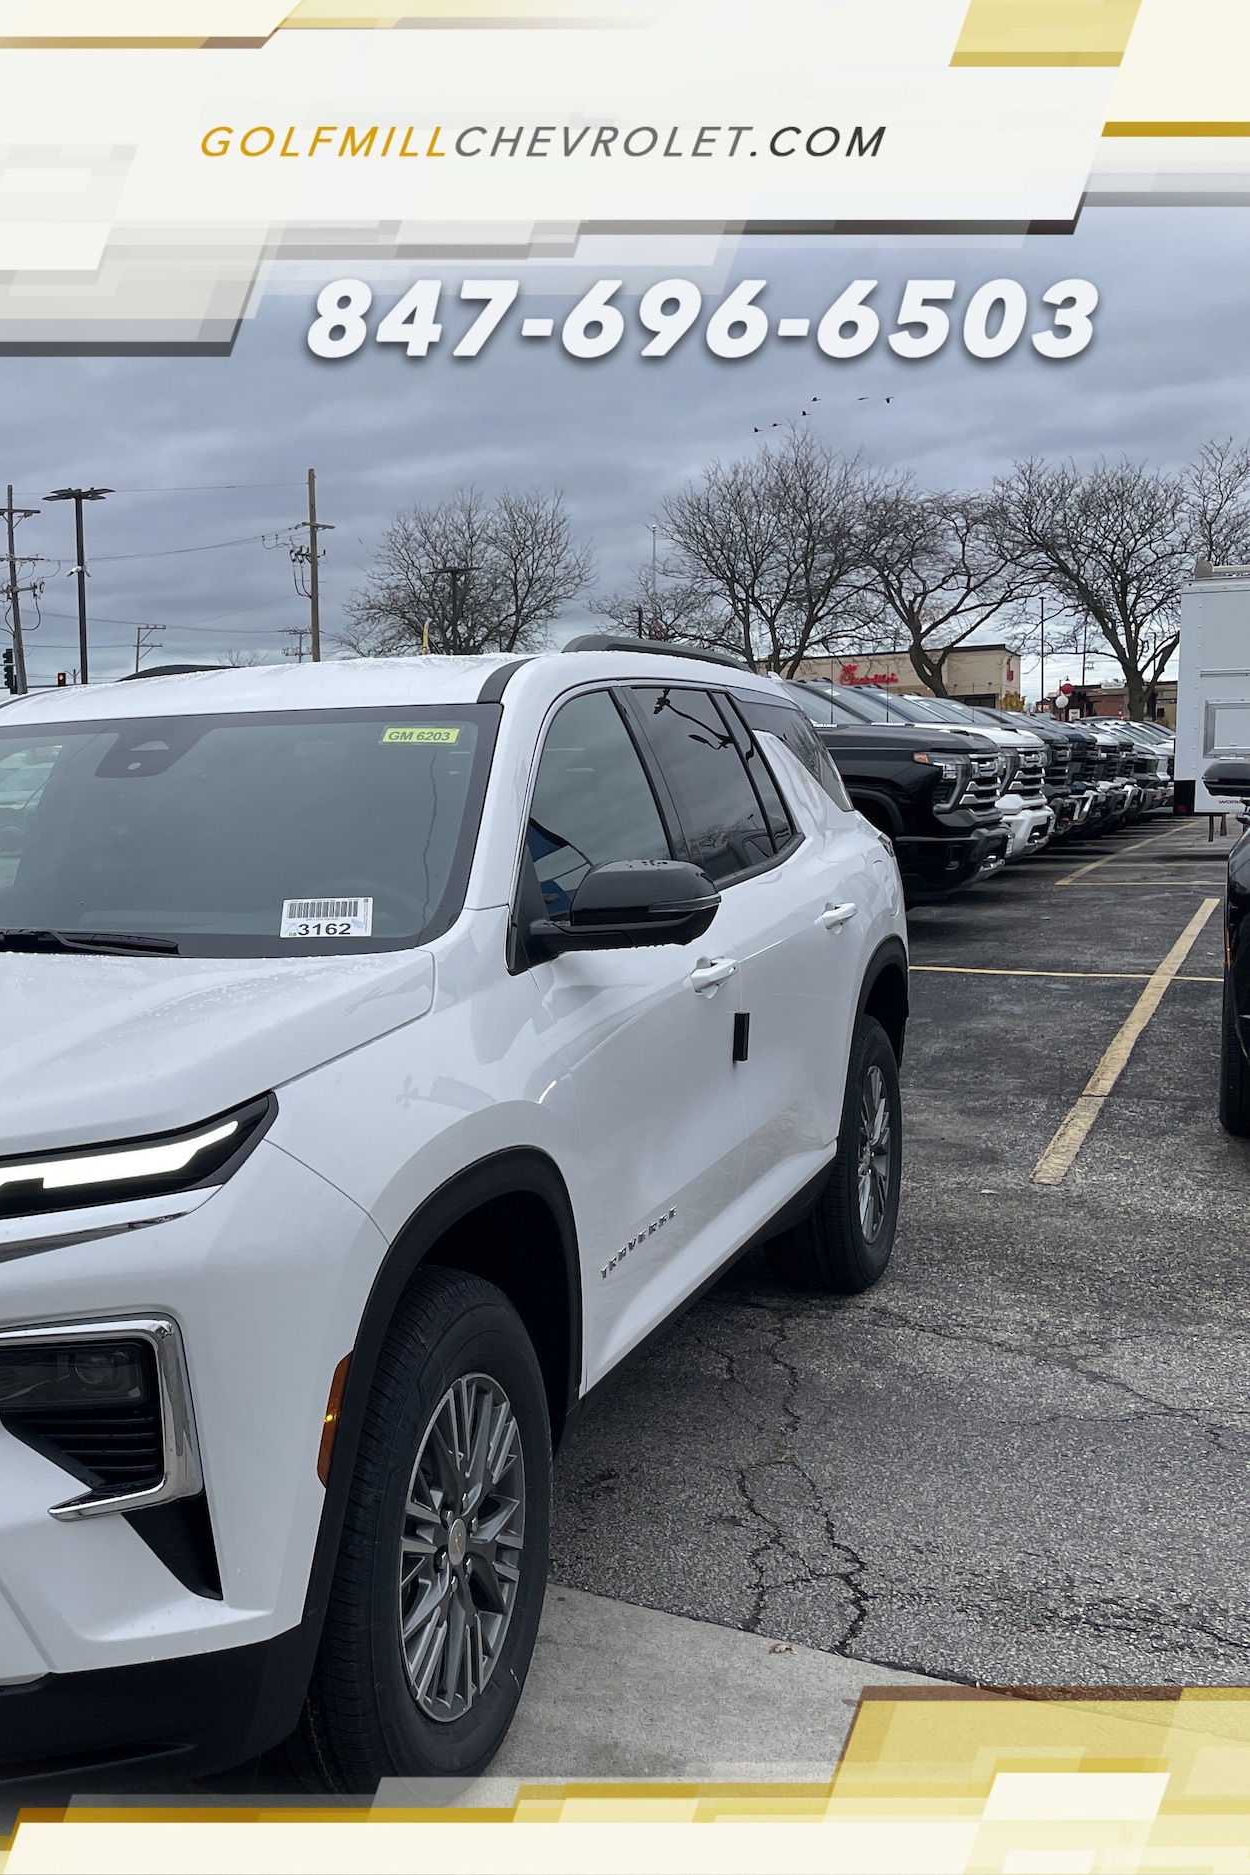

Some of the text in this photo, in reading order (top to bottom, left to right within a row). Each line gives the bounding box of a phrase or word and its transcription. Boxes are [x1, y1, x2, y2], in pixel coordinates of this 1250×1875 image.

[388, 731, 451, 741] GM 6203
[298, 923, 351, 936] 3162
